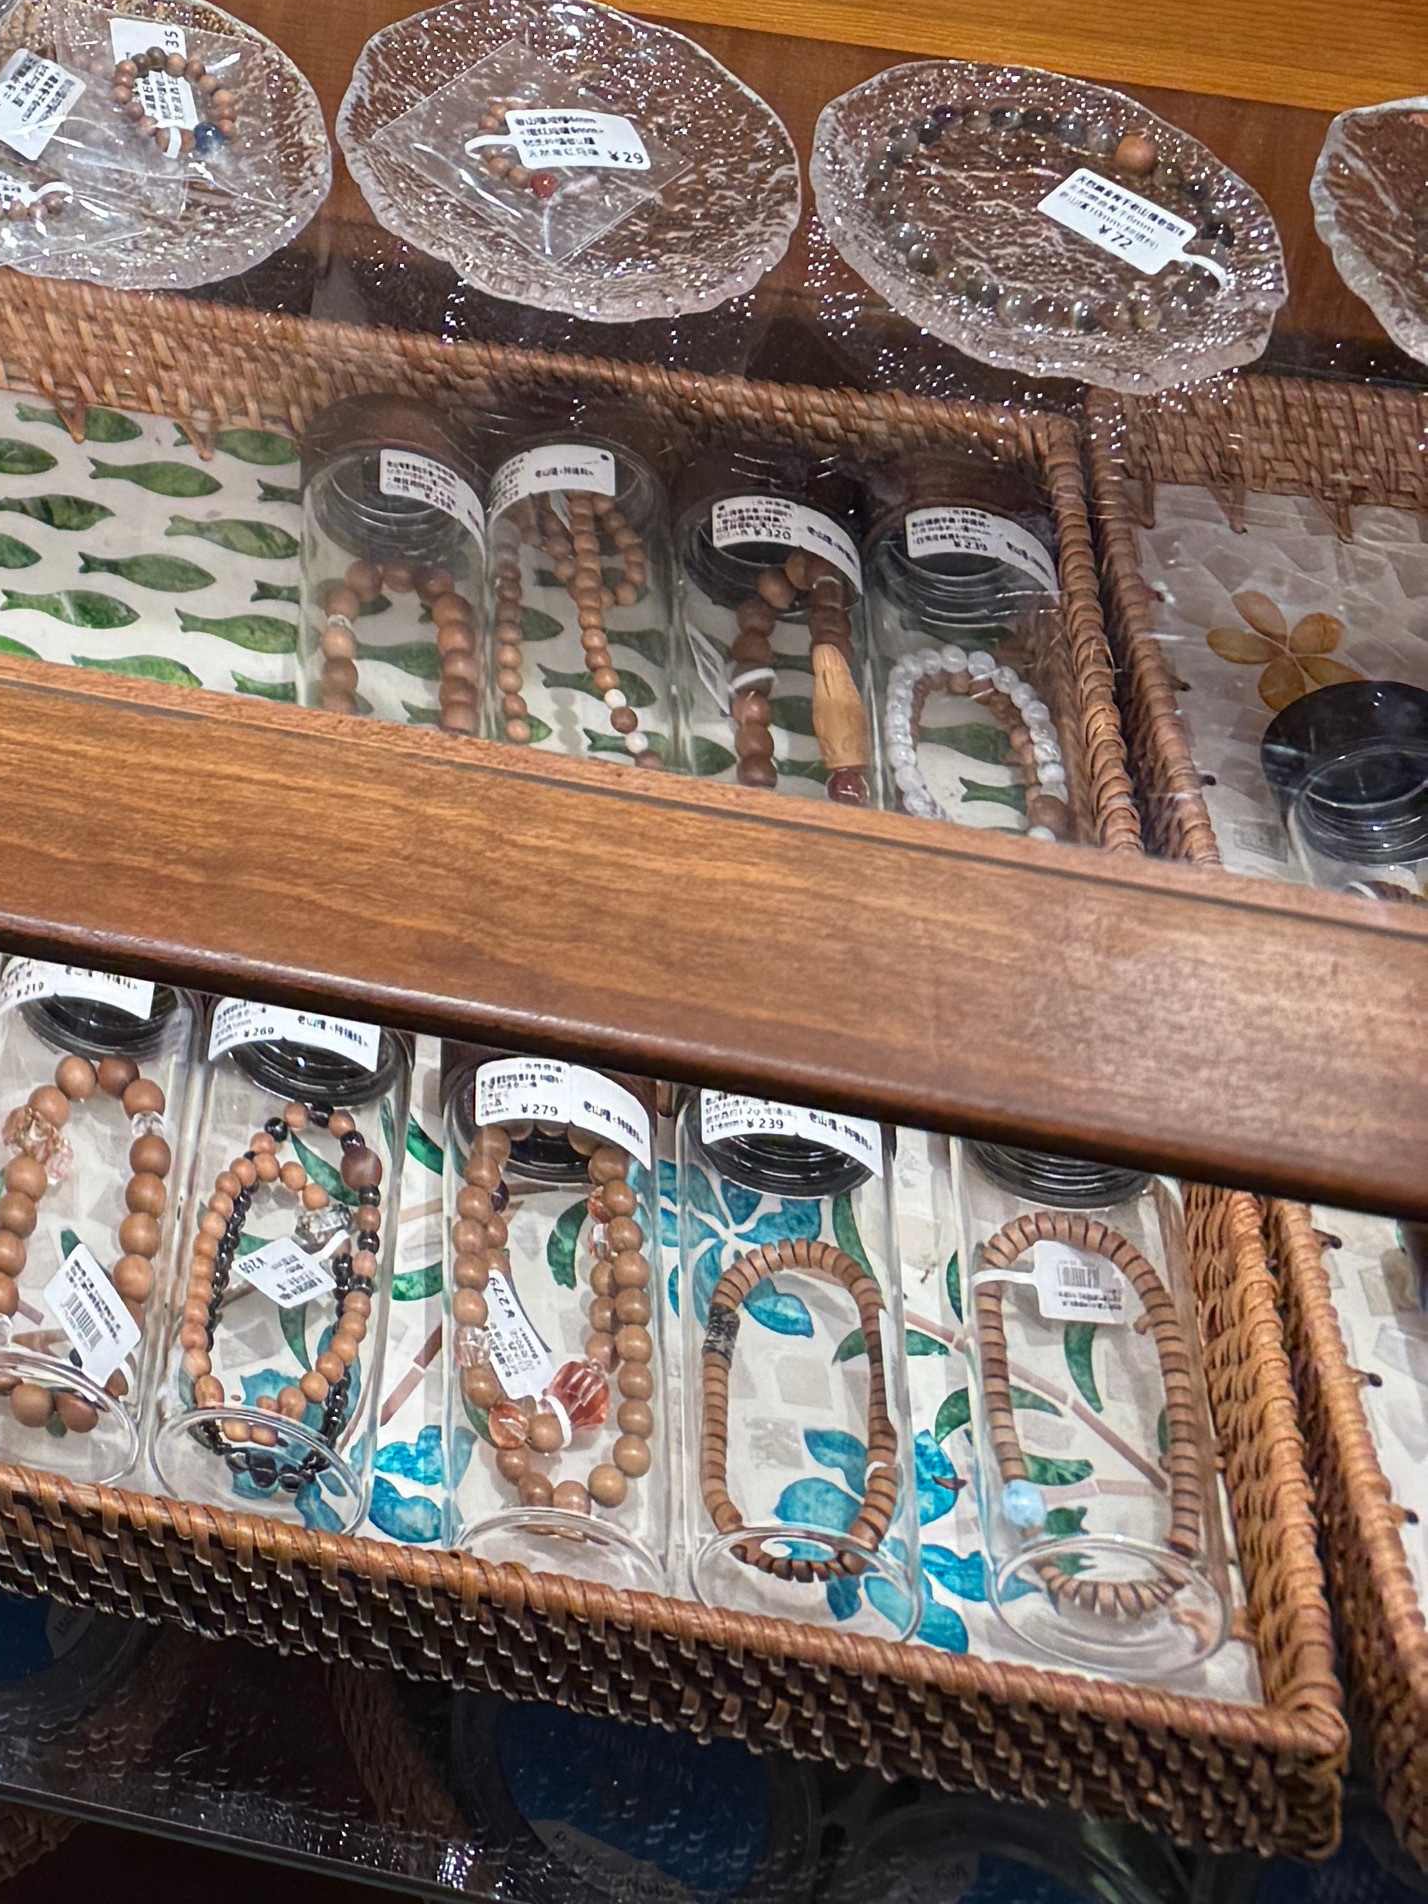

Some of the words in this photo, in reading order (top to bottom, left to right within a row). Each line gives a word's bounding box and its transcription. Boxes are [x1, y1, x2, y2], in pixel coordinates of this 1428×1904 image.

[608, 150, 644, 164] ¥29
[1099, 224, 1133, 250] ¥72
[754, 528, 792, 540] ¥320
[244, 1026, 275, 1038] ¥269
[520, 1103, 559, 1117] ¥279
[746, 1117, 784, 1130] ¥239
